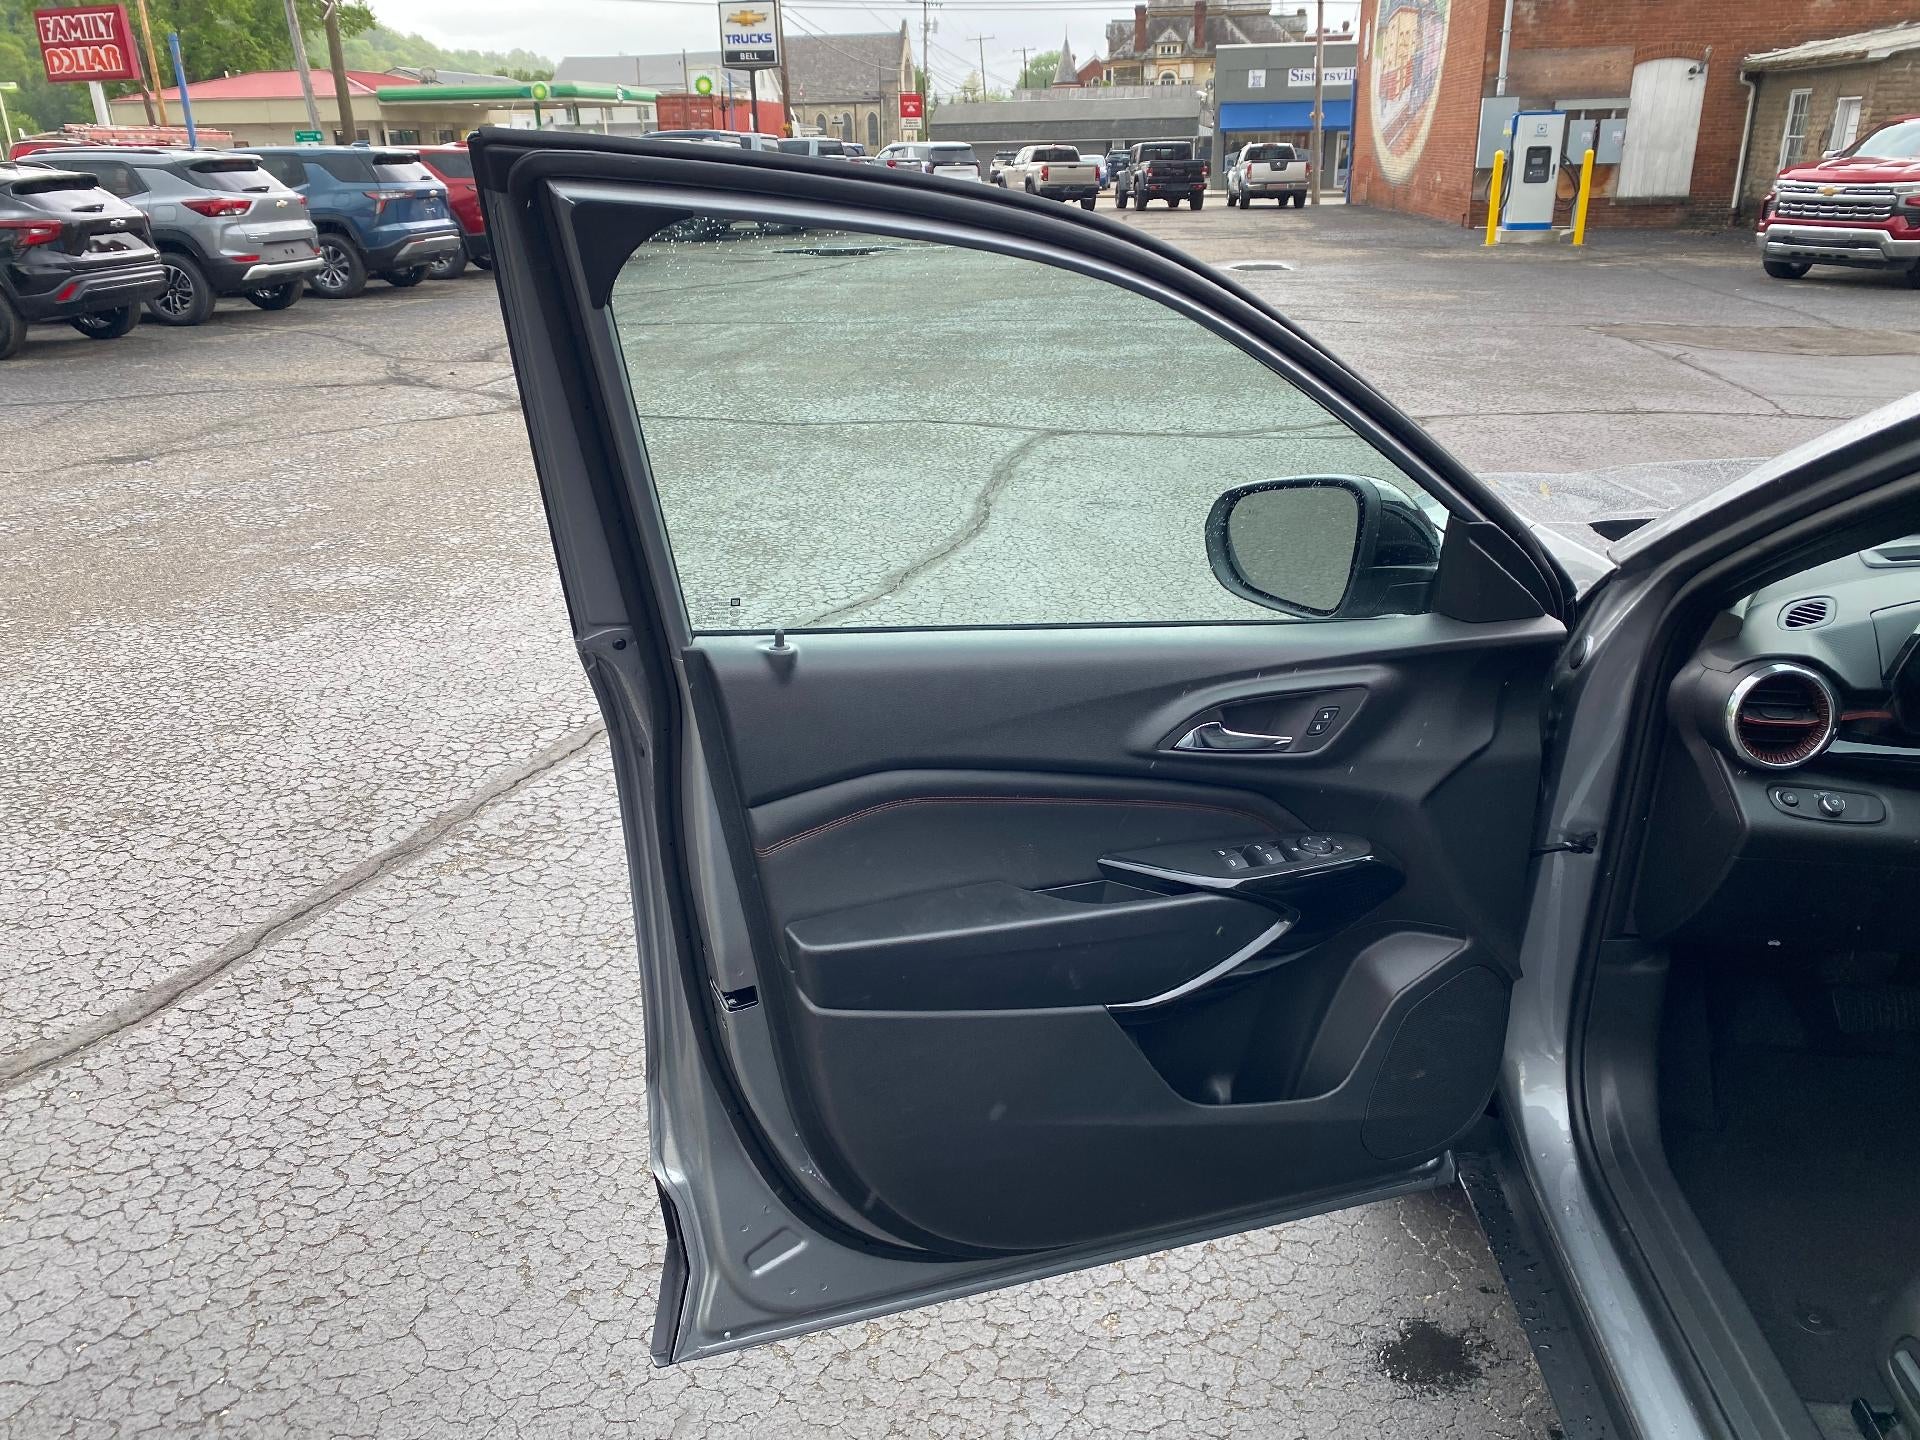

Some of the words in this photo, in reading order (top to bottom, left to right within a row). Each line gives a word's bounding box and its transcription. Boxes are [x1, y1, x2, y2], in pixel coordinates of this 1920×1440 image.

[39, 13, 114, 43] FAMILY
[725, 33, 773, 44] TRUCKS
[45, 44, 123, 74] DOLLAR
[740, 52, 759, 60] BELL
[1290, 68, 1356, 81] Sistrsvill
